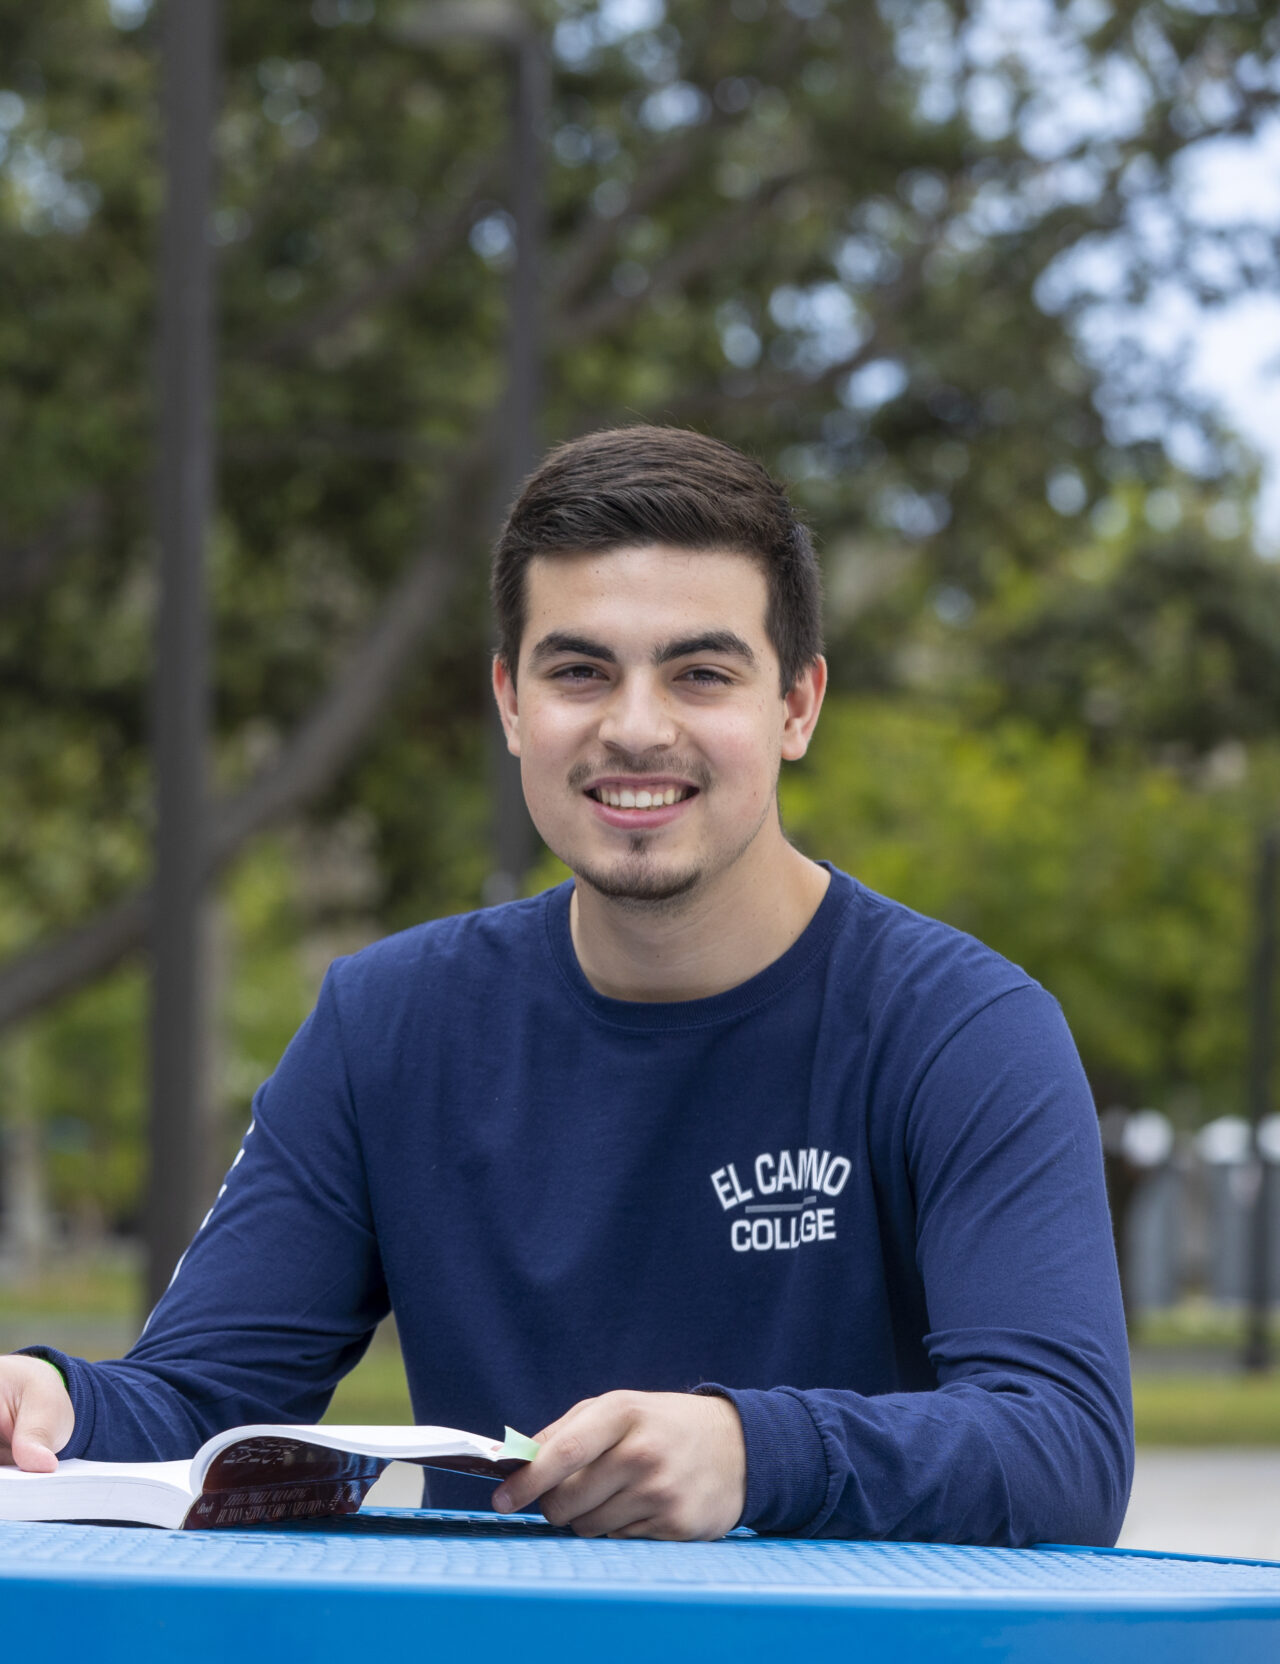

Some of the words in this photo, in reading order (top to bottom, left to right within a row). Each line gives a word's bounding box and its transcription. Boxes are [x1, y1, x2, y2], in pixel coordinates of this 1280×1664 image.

[710, 1163, 754, 1210] EL
[754, 1148, 851, 1196] CAMNO
[731, 1208, 836, 1252] COLLGE
